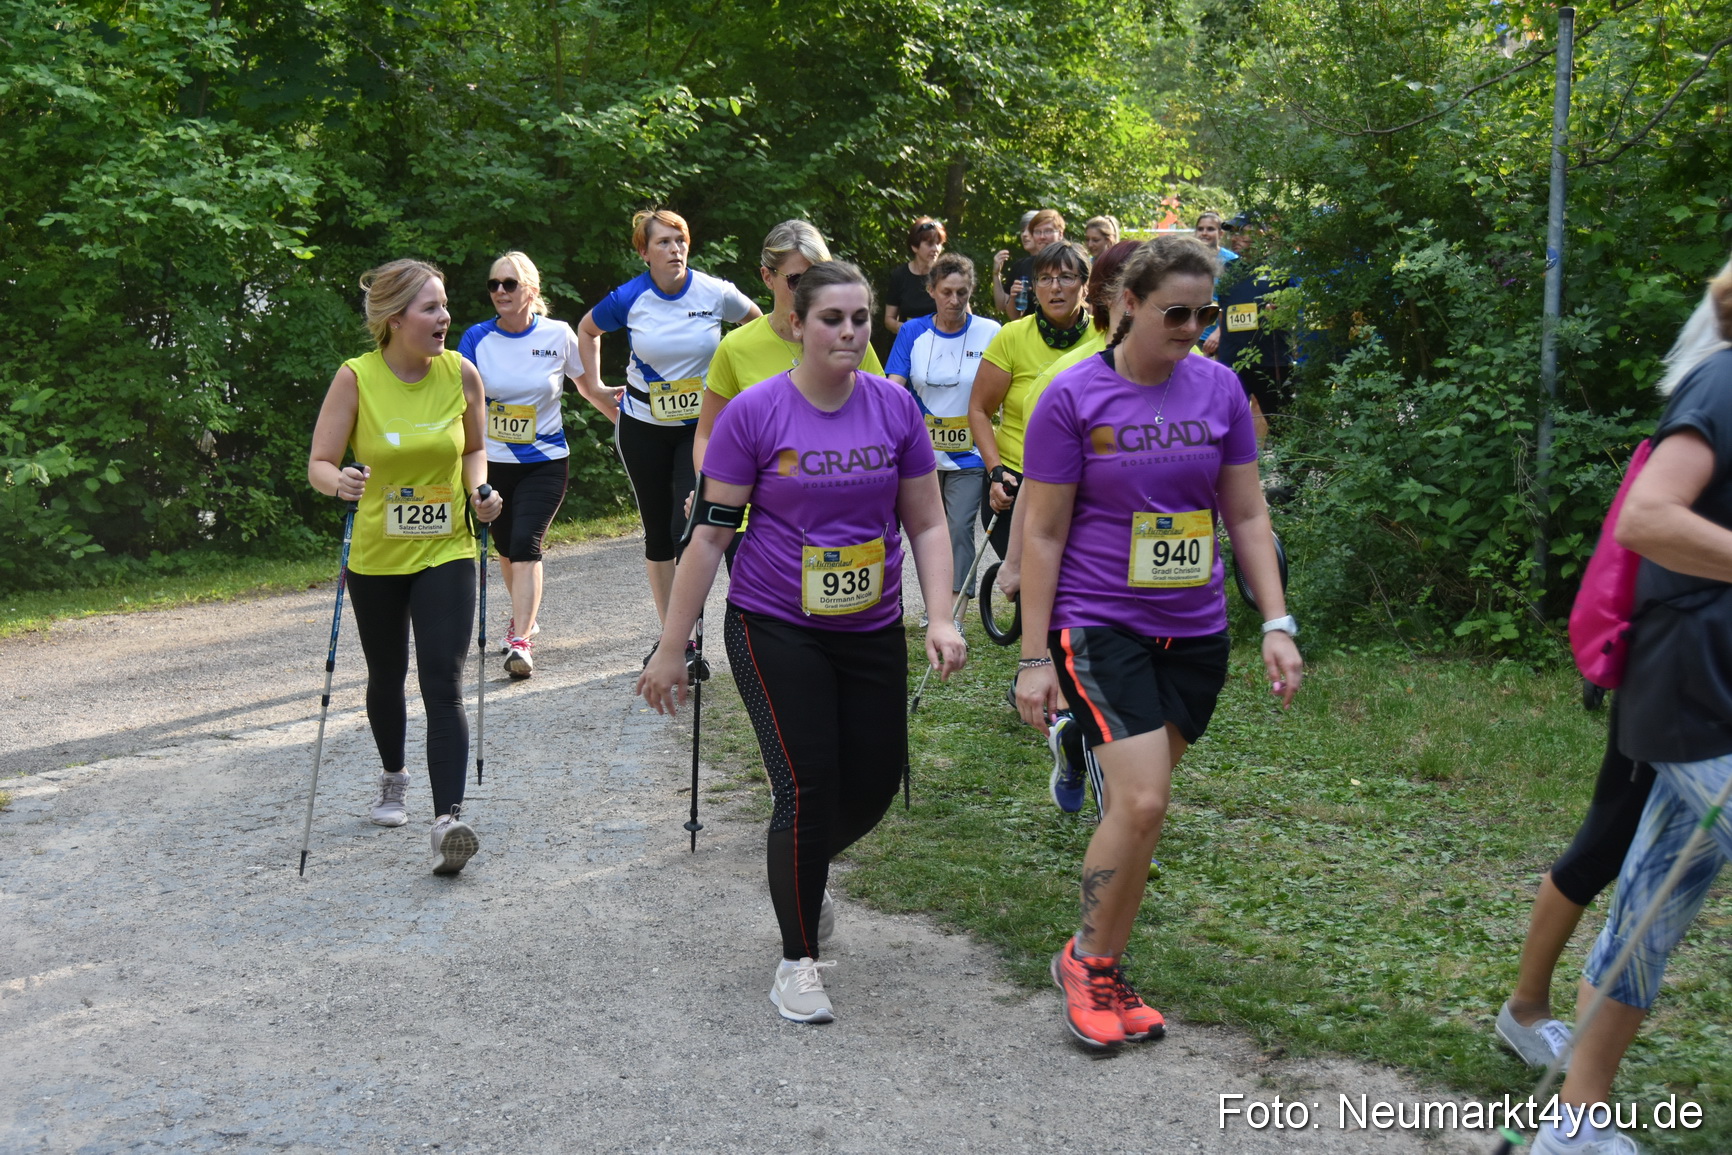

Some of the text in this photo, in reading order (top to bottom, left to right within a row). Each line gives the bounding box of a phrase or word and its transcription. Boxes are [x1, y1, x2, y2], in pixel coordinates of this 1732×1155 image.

[1230, 313, 1252, 323] 1401
[658, 392, 699, 411] 1102
[493, 416, 529, 433] 1107
[930, 428, 967, 443] 1106
[1117, 420, 1219, 453] GRADL
[800, 444, 896, 476] GRADL
[393, 503, 448, 525] 1284
[1152, 538, 1200, 567] 940
[1152, 567, 1172, 575] Gradl
[823, 568, 870, 596] 938
[856, 591, 873, 600] Nicole
